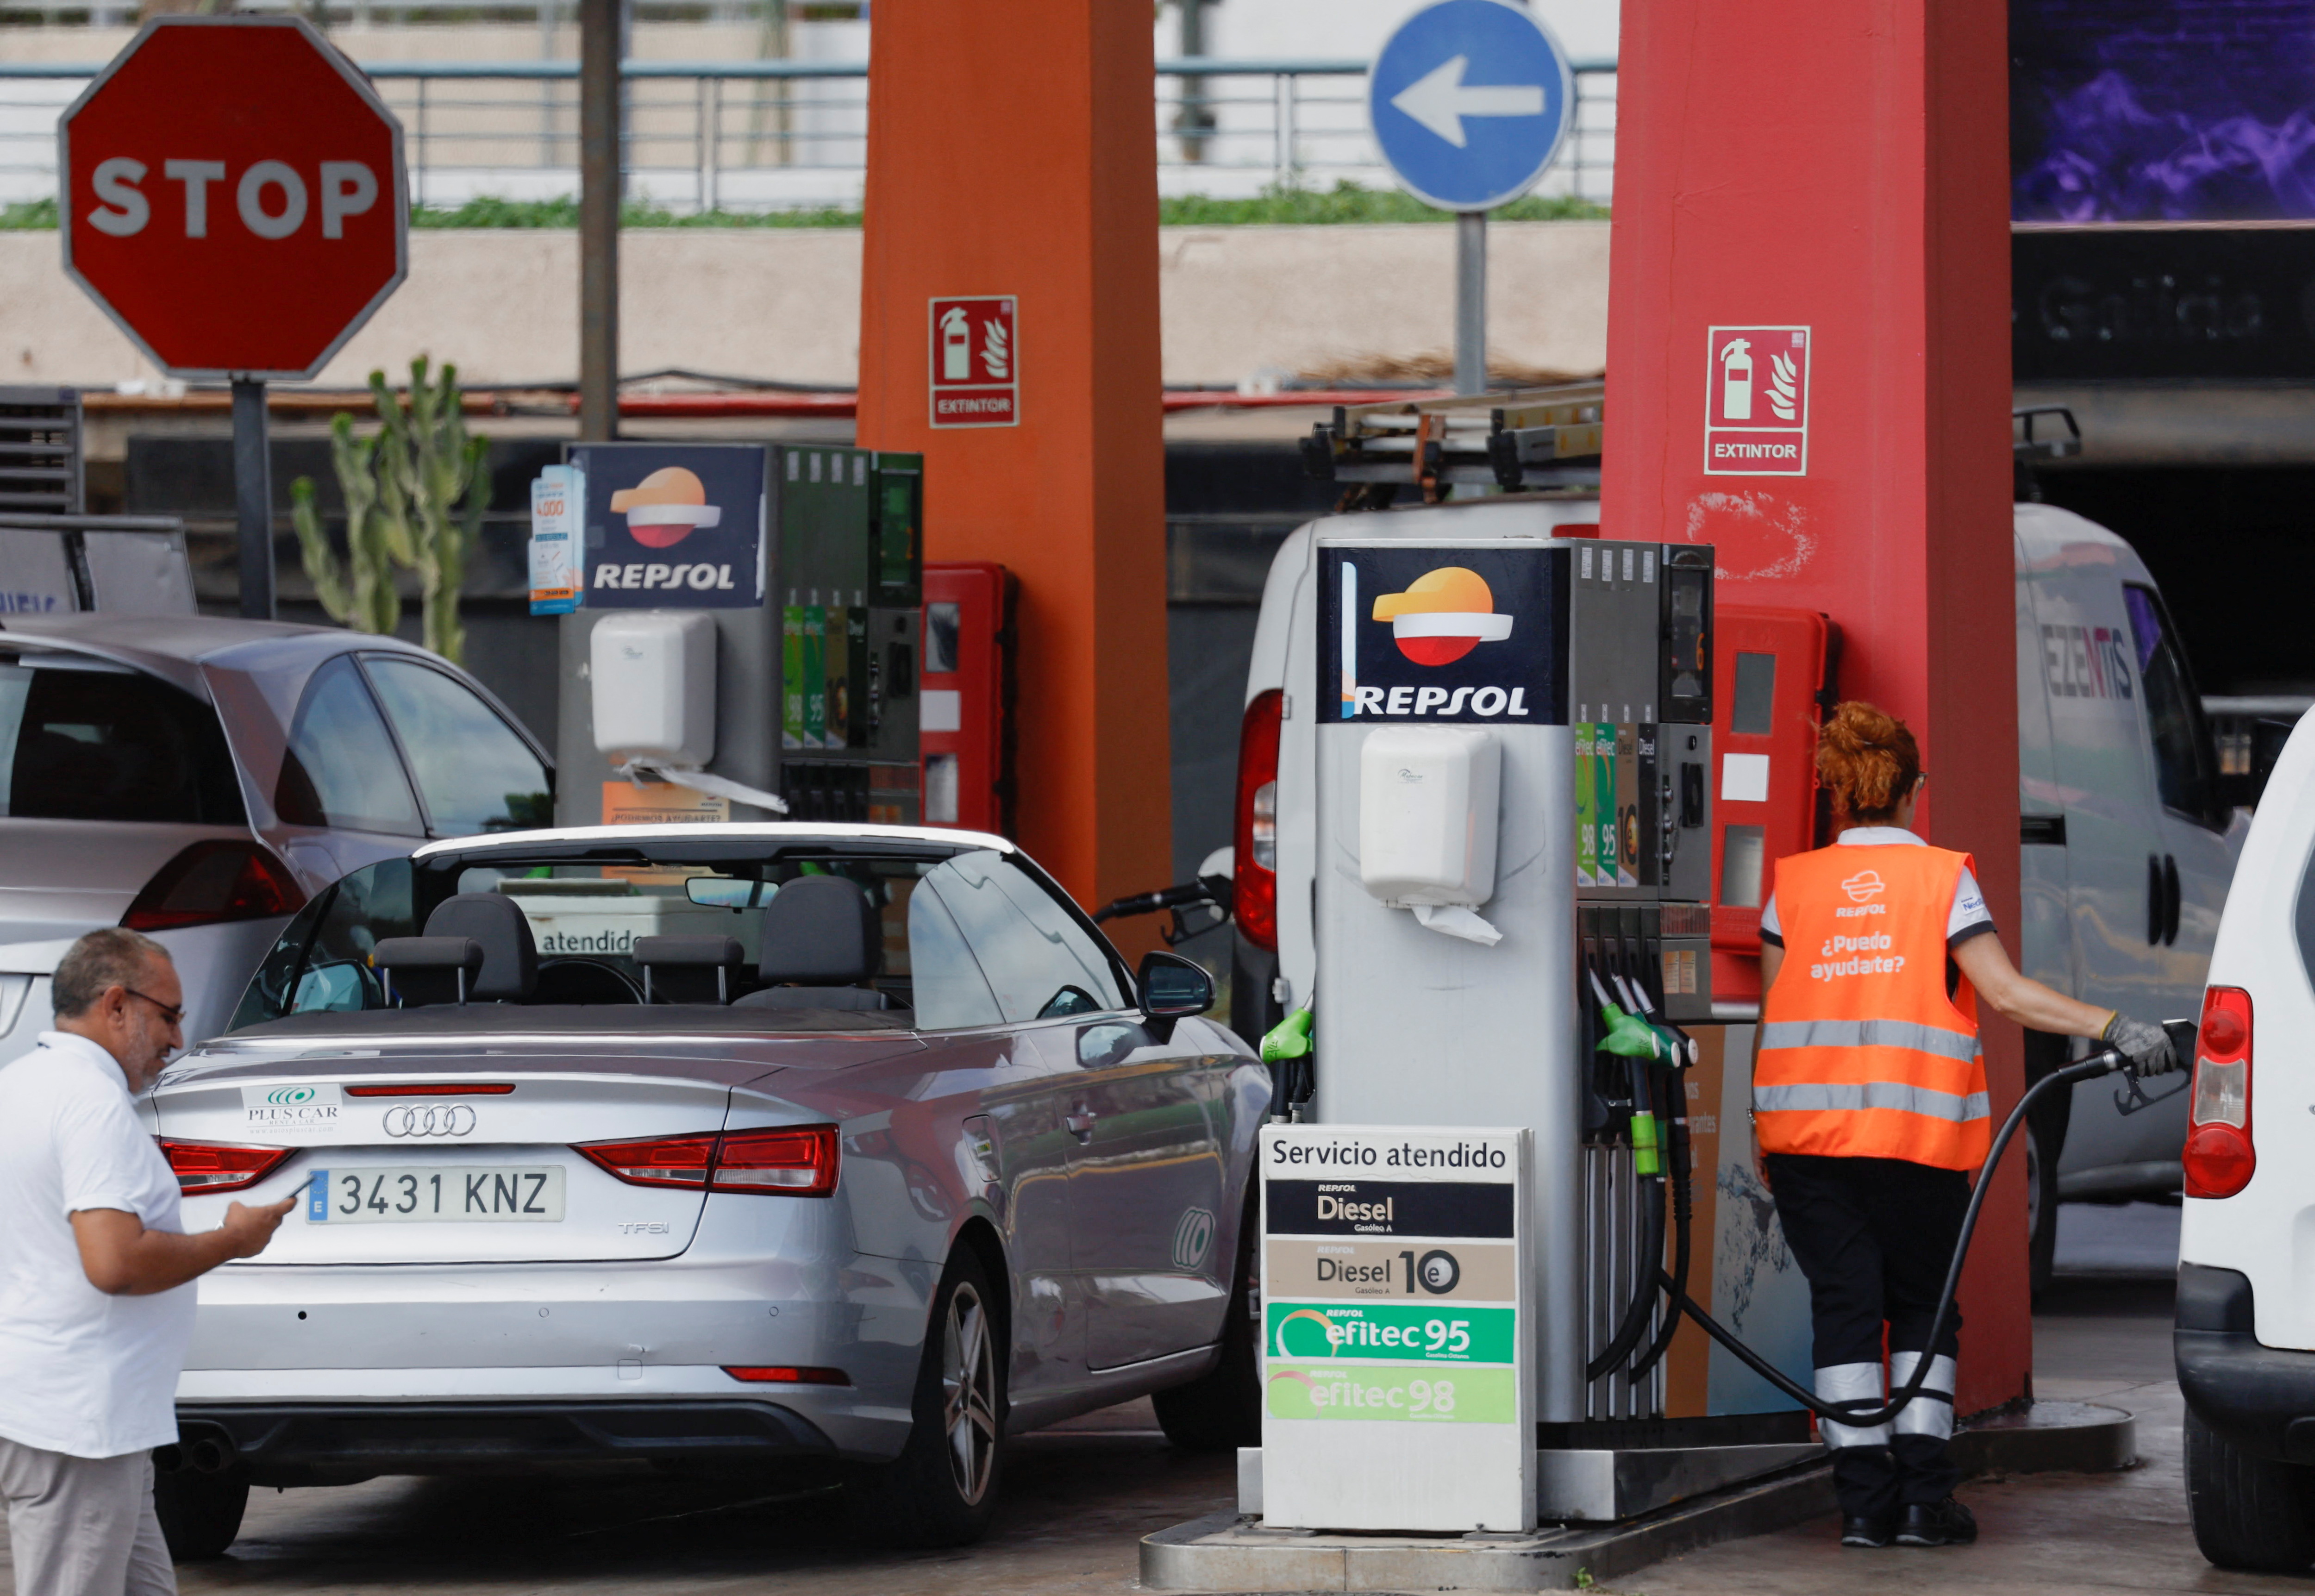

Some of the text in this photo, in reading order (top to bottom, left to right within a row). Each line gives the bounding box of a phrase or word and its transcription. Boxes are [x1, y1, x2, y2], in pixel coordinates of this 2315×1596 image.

[87, 156, 379, 239] STOP
[938, 399, 1011, 414] EXTINTOR
[1715, 444, 1797, 458] EXTINTOR
[593, 563, 734, 590] REPSOL
[1696, 632, 1704, 671] 6
[2041, 624, 2133, 700] EZENTIS
[1354, 686, 1528, 716] REPSOL
[1582, 824, 1594, 856] 98
[1602, 824, 1615, 856] 95
[1836, 904, 1886, 917] REPSOL
[1821, 931, 1891, 957] ¿Puedo
[248, 1107, 338, 1120] PLUS CAR
[250, 1126, 334, 1135] www.autospluscar.com
[1273, 1139, 1506, 1169] Servicio atendido
[339, 1173, 547, 1214] 3431 KNZ
[1318, 1184, 1356, 1192] REPSOL
[313, 1201, 323, 1213] E
[1318, 1195, 1393, 1221] Diesel
[618, 1222, 669, 1234] TFSI
[1354, 1223, 1385, 1232] Gasóleo
[1317, 1246, 1355, 1254] REPSOL
[1317, 1258, 1390, 1283] Diesel
[1355, 1287, 1383, 1295] Gasóleo
[1326, 1309, 1364, 1317] REPSOL
[1326, 1319, 1470, 1352] efitec 95
[1310, 1380, 1455, 1412] efitec 98
